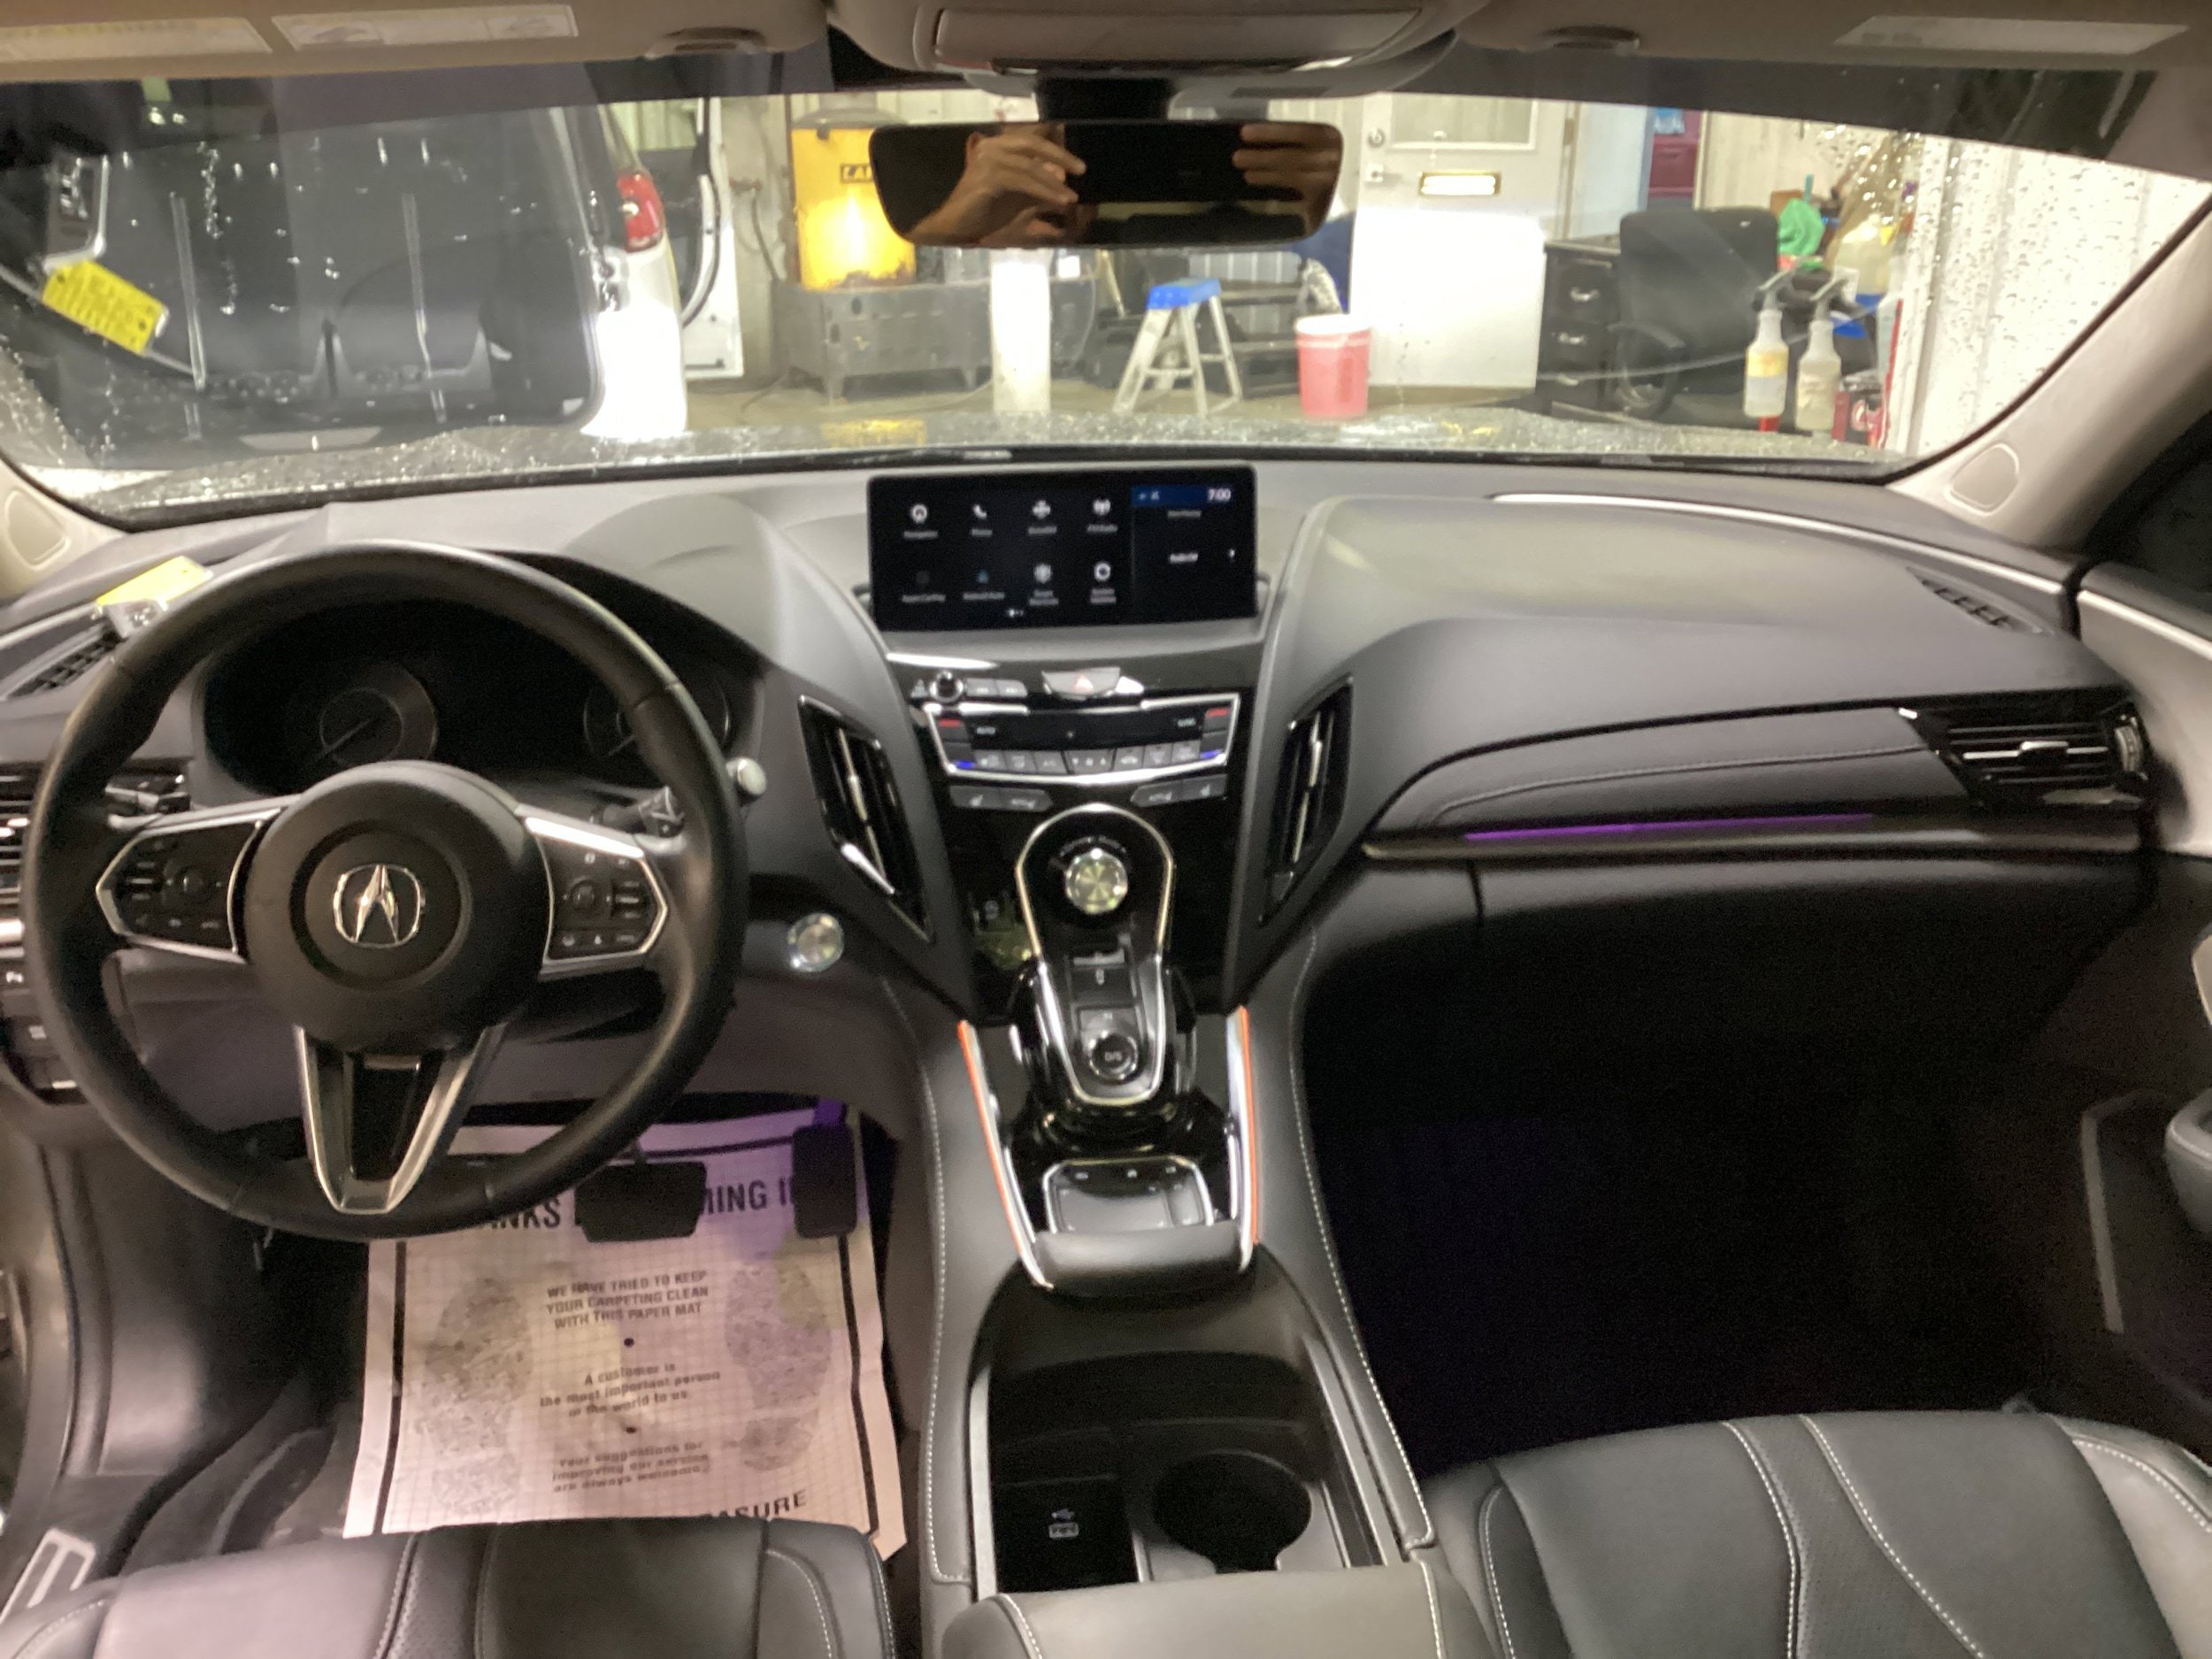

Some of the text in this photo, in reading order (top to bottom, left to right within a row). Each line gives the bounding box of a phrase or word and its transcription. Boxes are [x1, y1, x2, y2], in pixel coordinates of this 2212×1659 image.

[707, 1179, 768, 1215] ING
[547, 1271, 707, 1298] WE HAVE TRIED TO KEEP
[546, 1286, 708, 1314] YOUR CARPETING CLEAN
[555, 1302, 702, 1329] WITH THIS PAPER MAT
[541, 1395, 561, 1407] the
[566, 1390, 600, 1403] most
[605, 1377, 670, 1398] important
